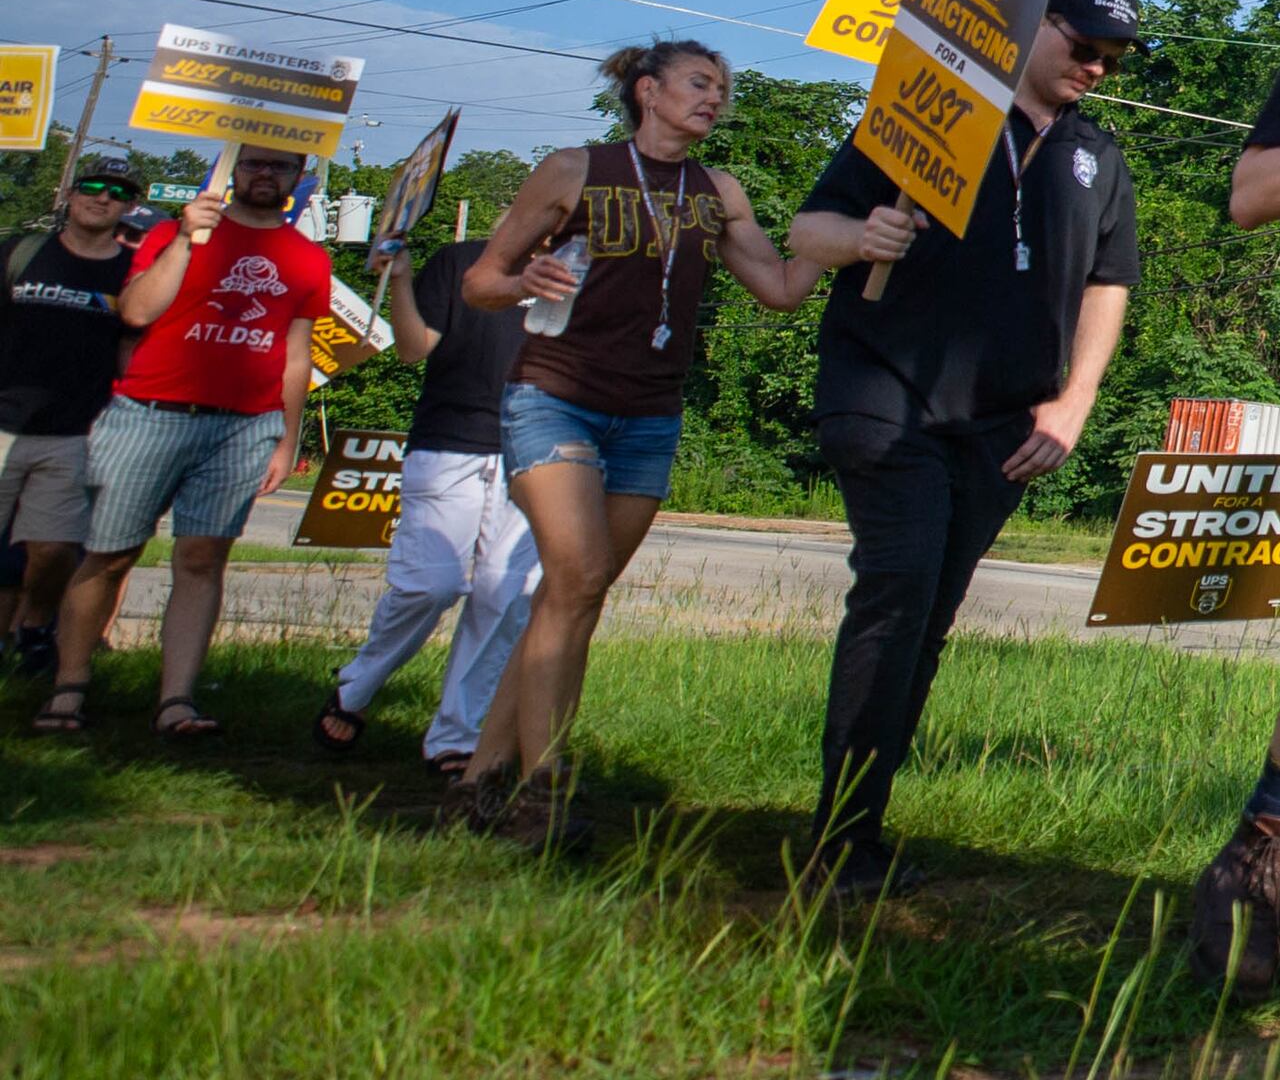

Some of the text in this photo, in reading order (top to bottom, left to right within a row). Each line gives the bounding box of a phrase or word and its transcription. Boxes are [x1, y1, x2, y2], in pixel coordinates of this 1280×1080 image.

[173, 36, 326, 72] UPS TEAMSTERS:
[934, 42, 967, 74] FOR A
[164, 59, 345, 103] JUST PRACTICING
[229, 96, 266, 109] FOR A
[899, 66, 973, 135] JUST
[150, 105, 327, 145] JUST CONTRACT
[868, 106, 968, 207] CONTRACT
[163, 185, 198, 200] Sea
[583, 186, 727, 261] UPS
[184, 322, 275, 346] ATLDSA
[312, 317, 357, 345] UST
[1213, 496, 1263, 508] FOR A
[1201, 575, 1229, 586] UPS
